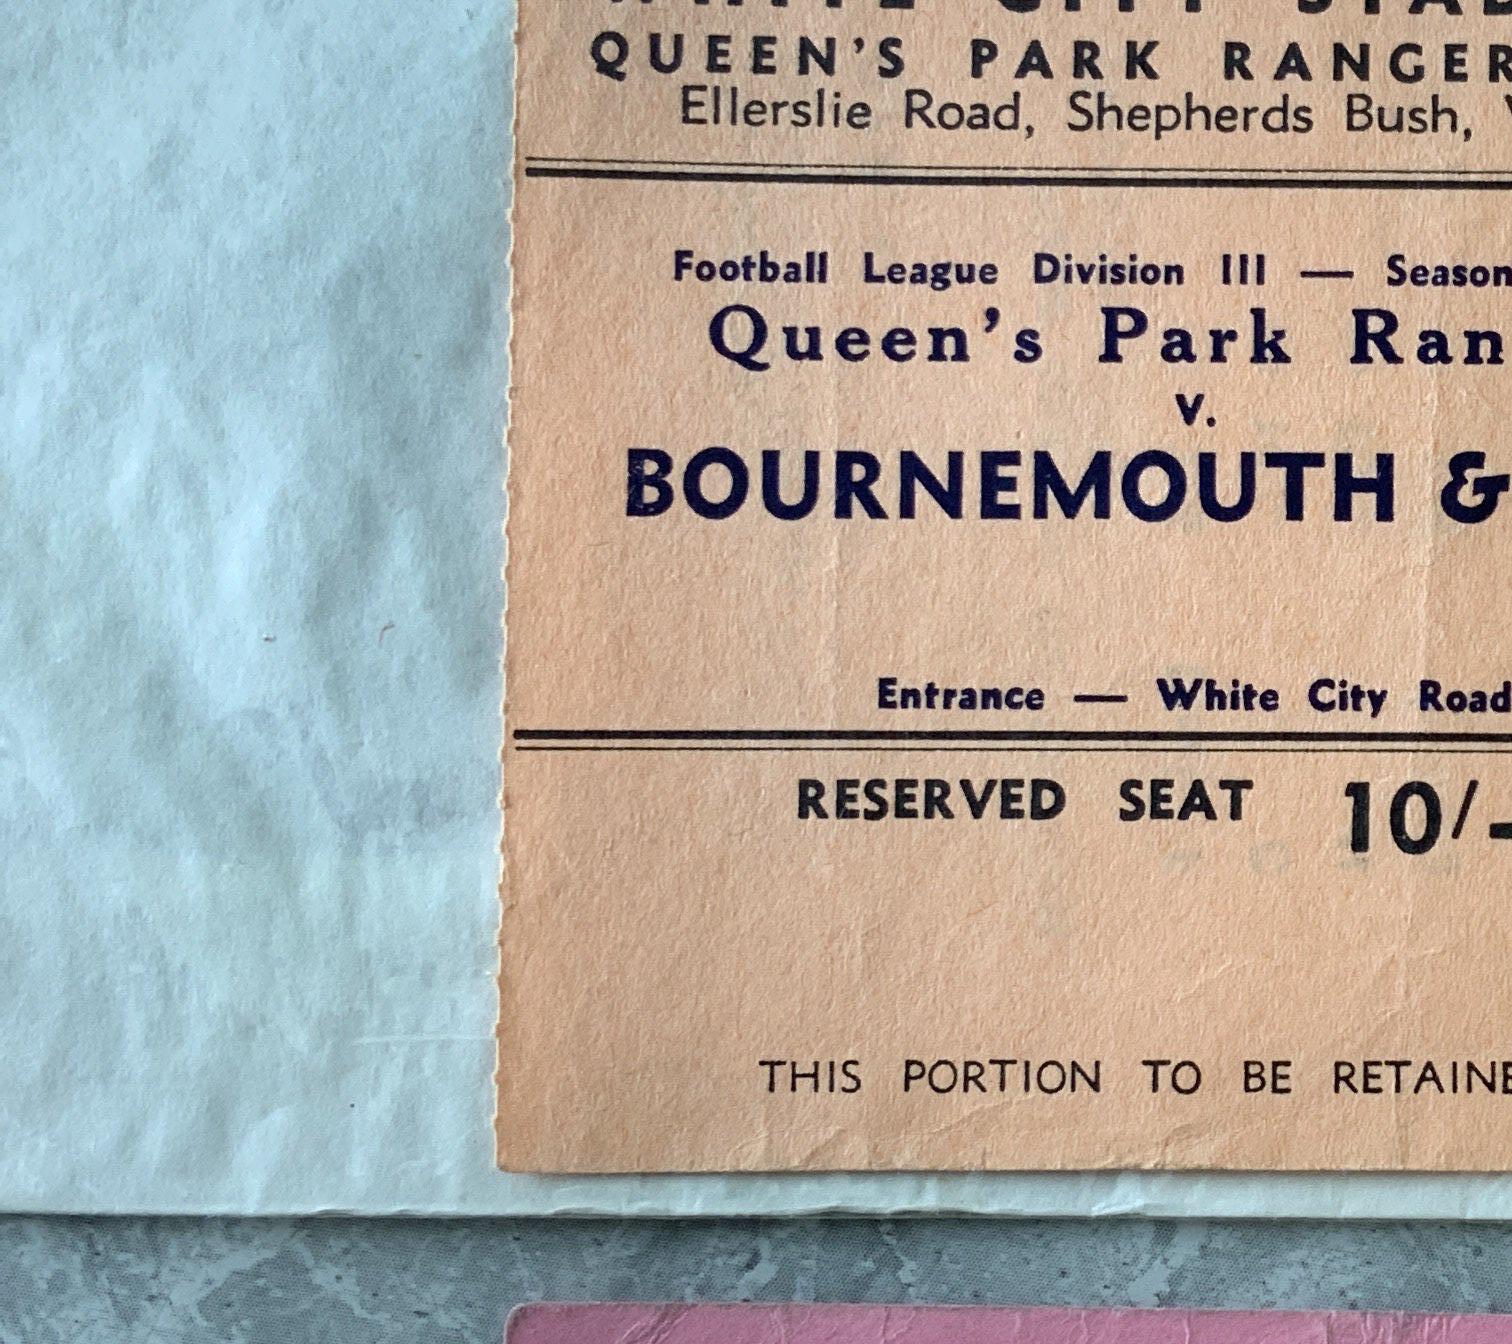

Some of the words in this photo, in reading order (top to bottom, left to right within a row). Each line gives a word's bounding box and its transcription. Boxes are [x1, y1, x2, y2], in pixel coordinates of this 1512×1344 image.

[589, 30, 905, 82] QUEEN'S
[970, 38, 1160, 80] PARK
[681, 84, 872, 130] Ellerslie
[904, 88, 1035, 139] Road,
[1067, 89, 1314, 141] Shepherds
[1346, 92, 1472, 142] Bush,
[673, 249, 828, 284] Football
[863, 251, 998, 292] League
[1033, 252, 1184, 286] Division
[1222, 253, 1265, 286] III
[708, 303, 1043, 372] Queen's
[1098, 306, 1292, 364] Park
[1175, 393, 1216, 428] v.
[625, 446, 1395, 523] BOURNEMOUTH
[1440, 450, 1511, 525] &
[877, 677, 1045, 711] Entrance
[1156, 677, 1279, 712] White
[1307, 677, 1388, 719] City
[1419, 679, 1512, 713] Road
[797, 778, 1066, 822] RESERVED
[1119, 778, 1254, 822] SEAT
[758, 1059, 862, 1094] THIS
[903, 1058, 1101, 1095] PORTION
[1141, 1059, 1202, 1095] TO
[1243, 1060, 1292, 1095] BE
